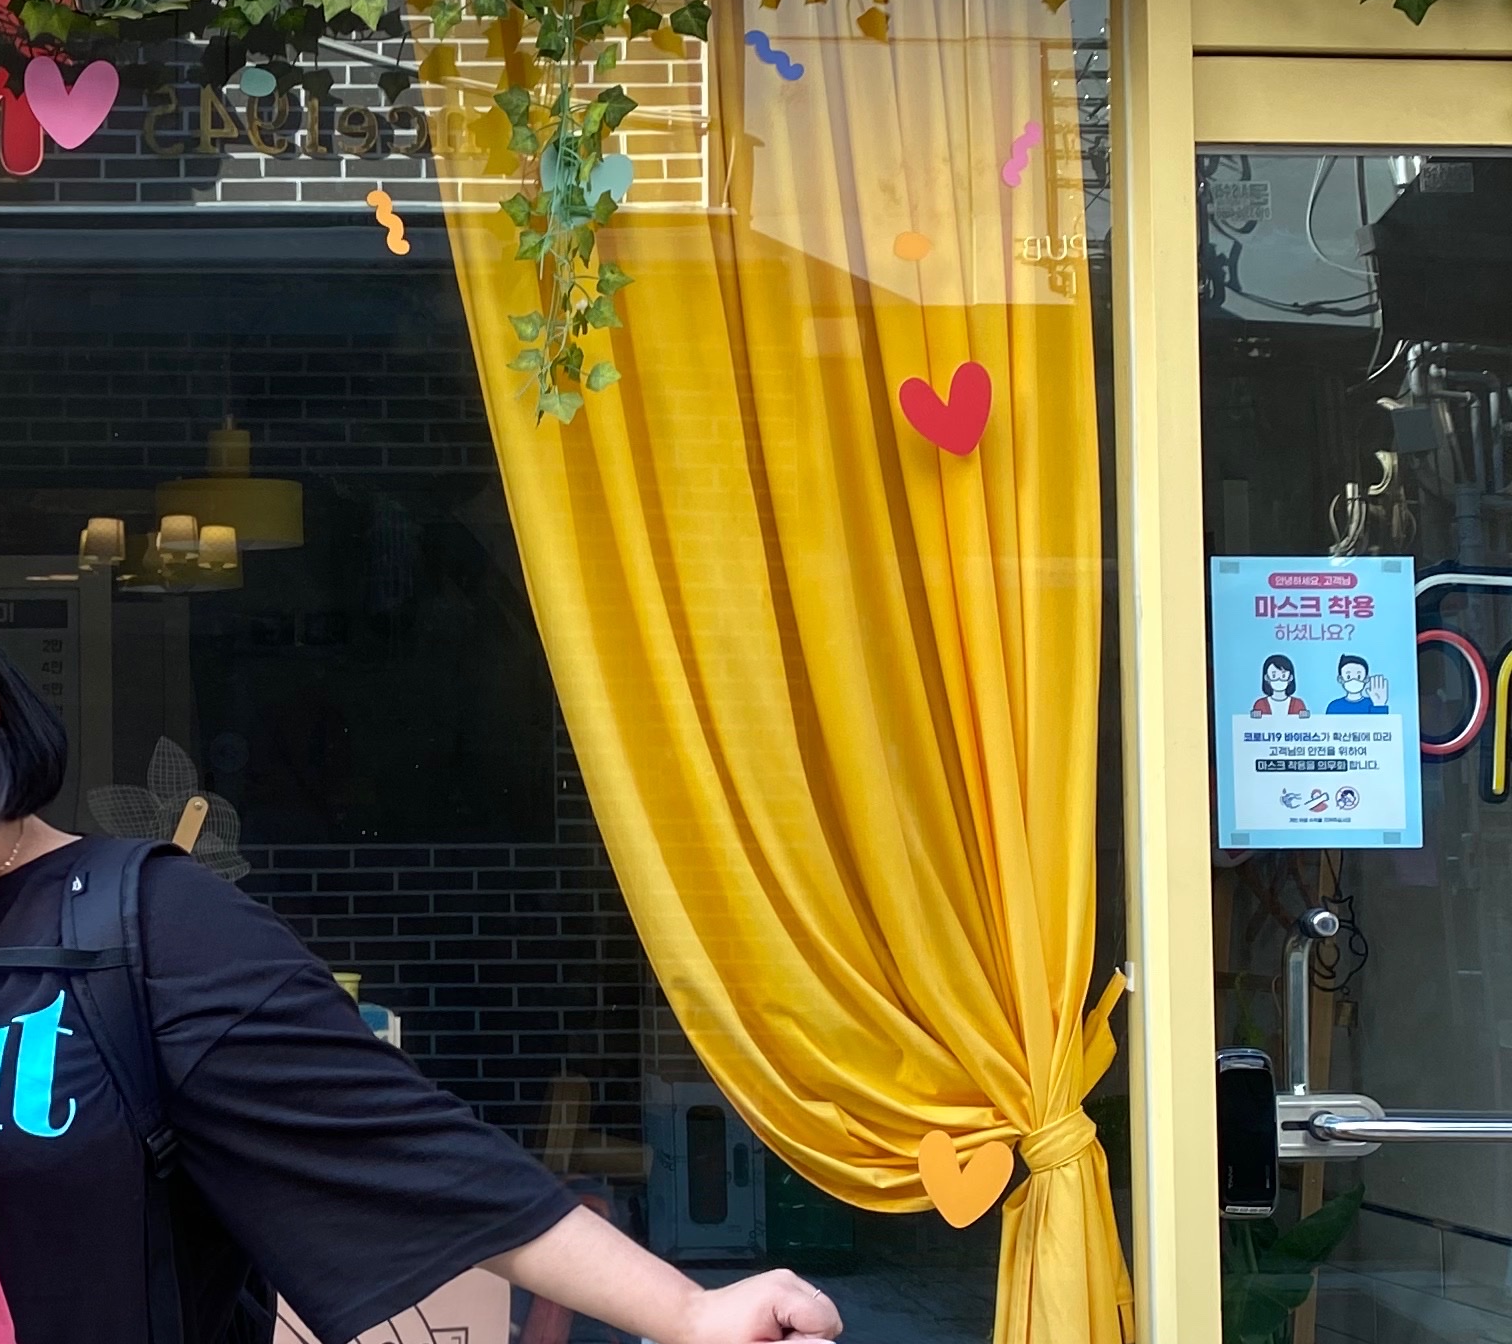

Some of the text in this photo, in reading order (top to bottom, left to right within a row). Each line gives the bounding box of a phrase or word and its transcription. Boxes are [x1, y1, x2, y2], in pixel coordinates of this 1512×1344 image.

[1255, 594, 1375, 619] 마스크 착용
[1274, 623, 1355, 641] 하셨나요?
[1244, 732, 1283, 742] 코로나19
[1284, 732, 1330, 742] 바이러스가
